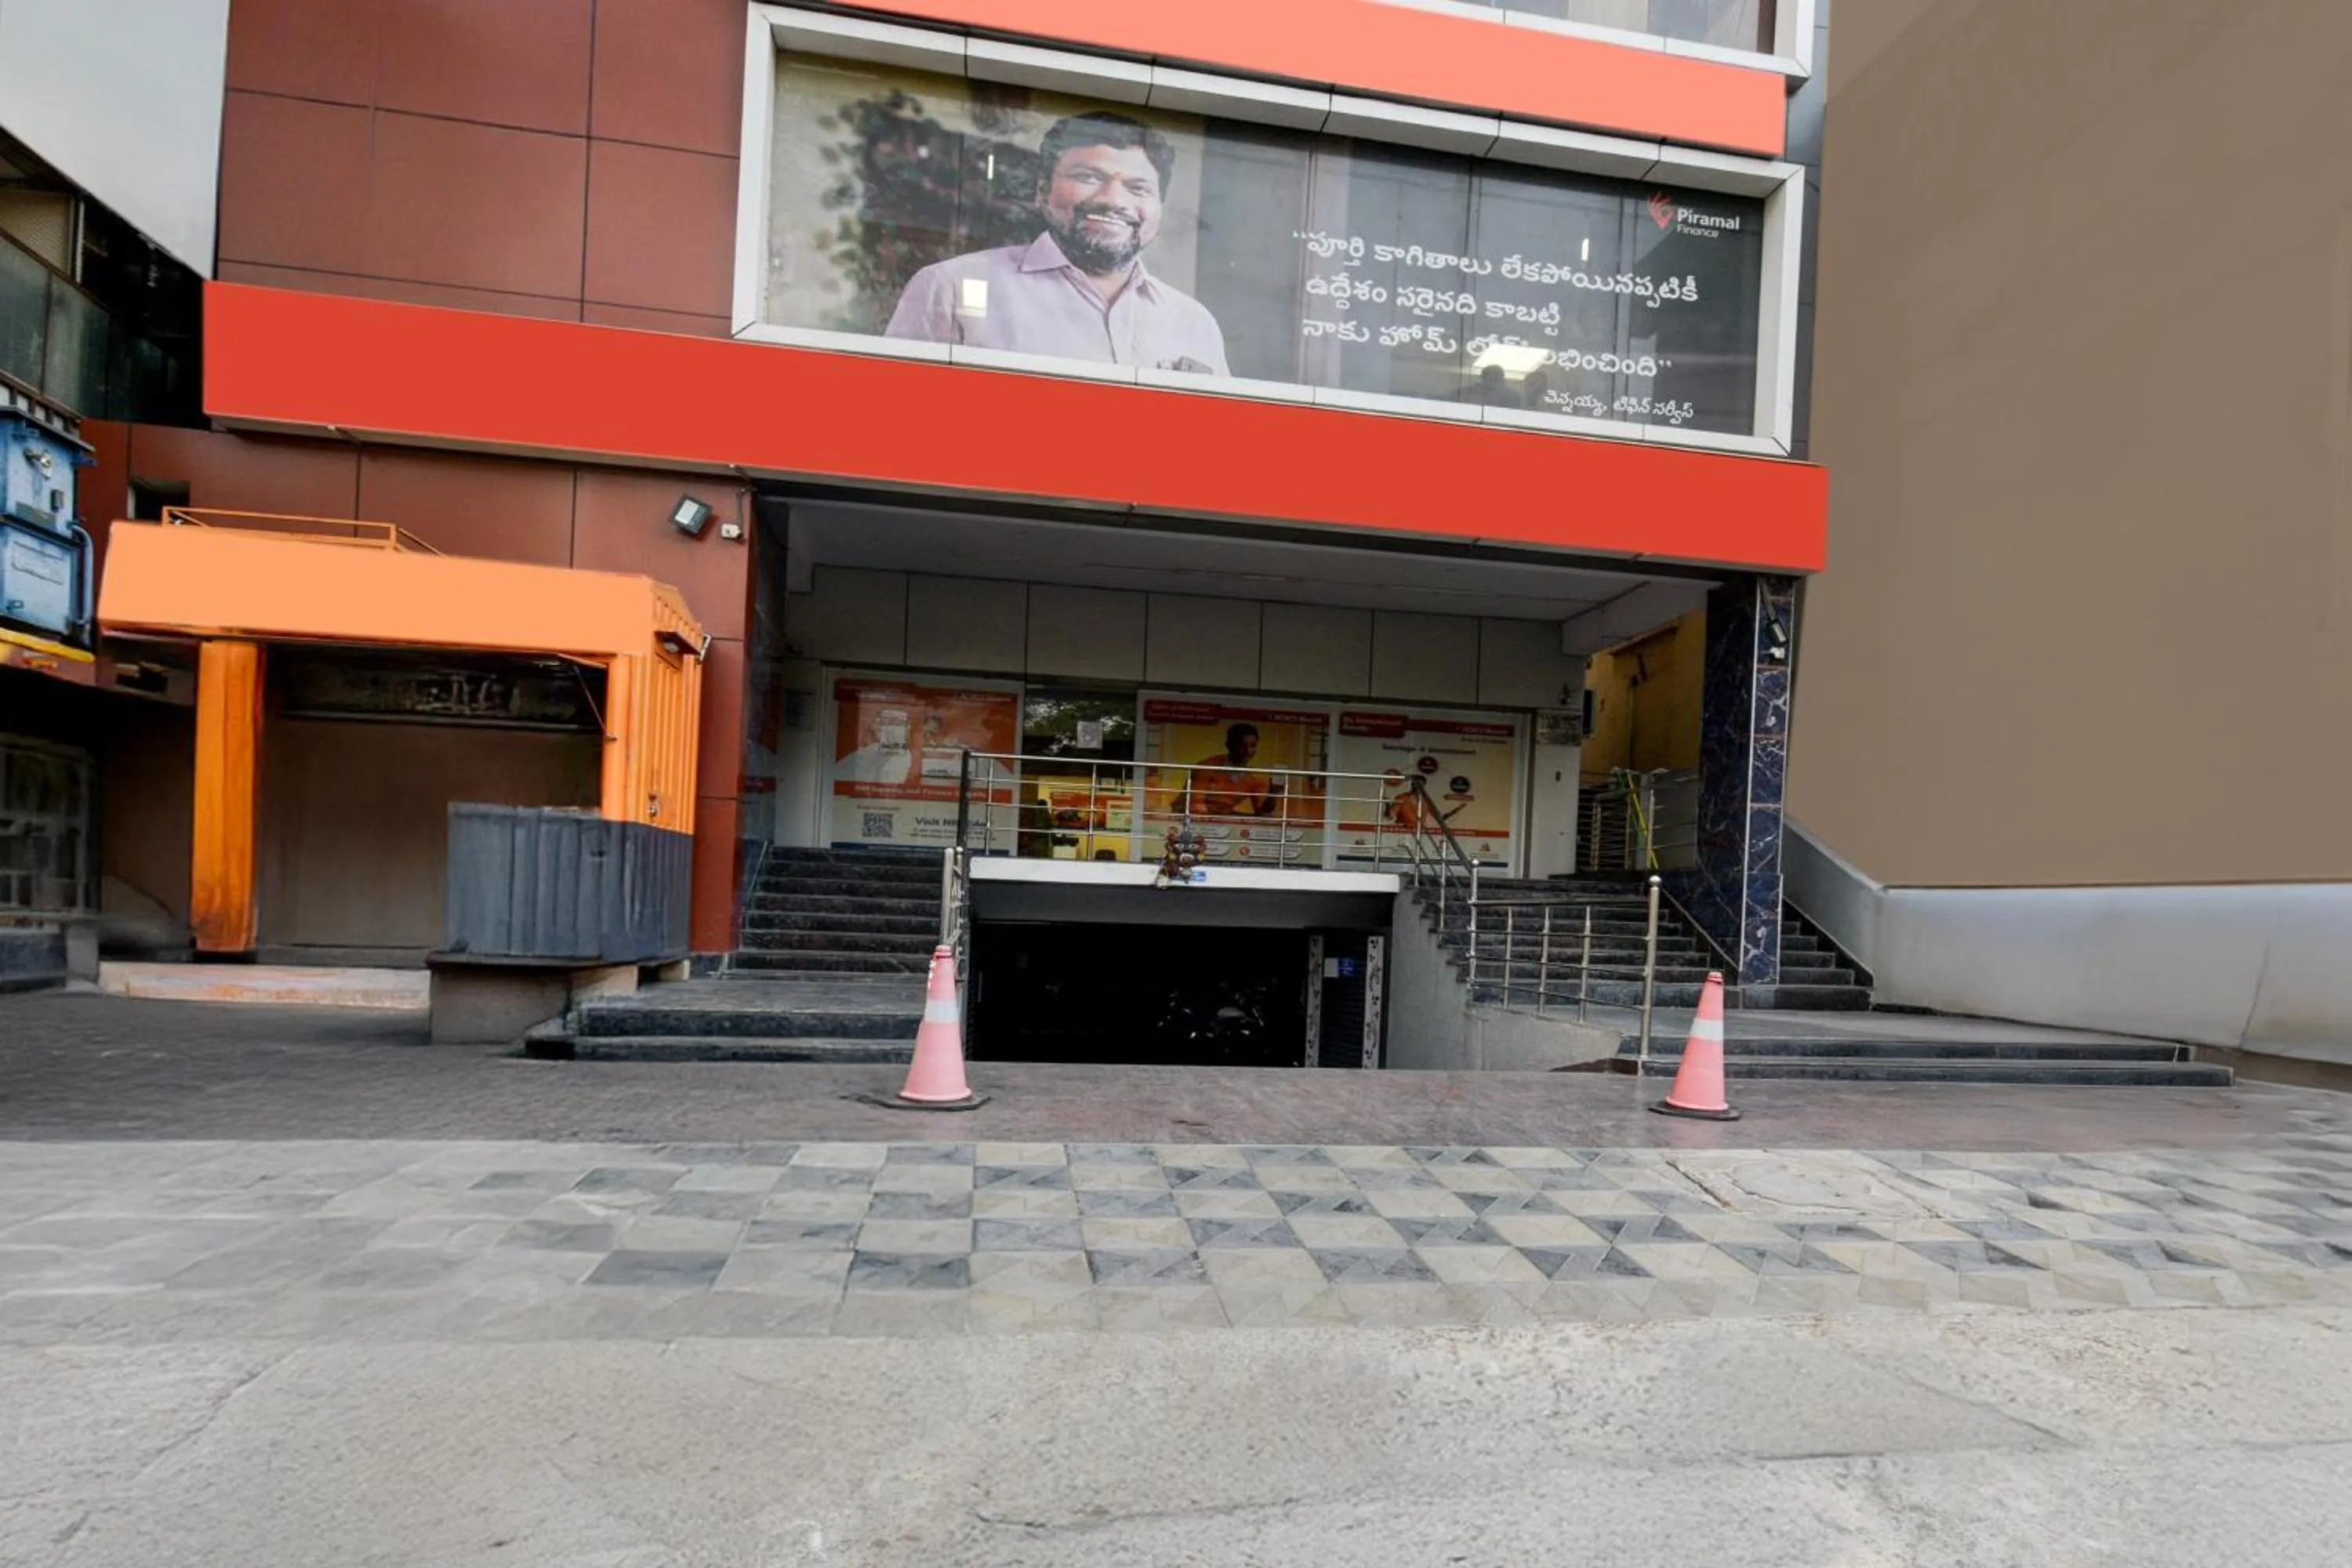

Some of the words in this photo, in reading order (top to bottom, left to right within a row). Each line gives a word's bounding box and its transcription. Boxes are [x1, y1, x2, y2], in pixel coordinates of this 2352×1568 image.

[1677, 208, 1740, 230] Piramal
[1677, 224, 1719, 238] Finance
[1374, 243, 1493, 276] కాగితాలు
[1501, 254, 1699, 308] లేకపోయినప్పటికీ
[1305, 271, 1388, 310] ఉద్దేశం
[1396, 285, 1477, 318] సరైనది
[1485, 301, 1561, 336] కాబట్టి
[1302, 318, 1370, 343] నాకు
[1379, 324, 1457, 354] హోమ్
